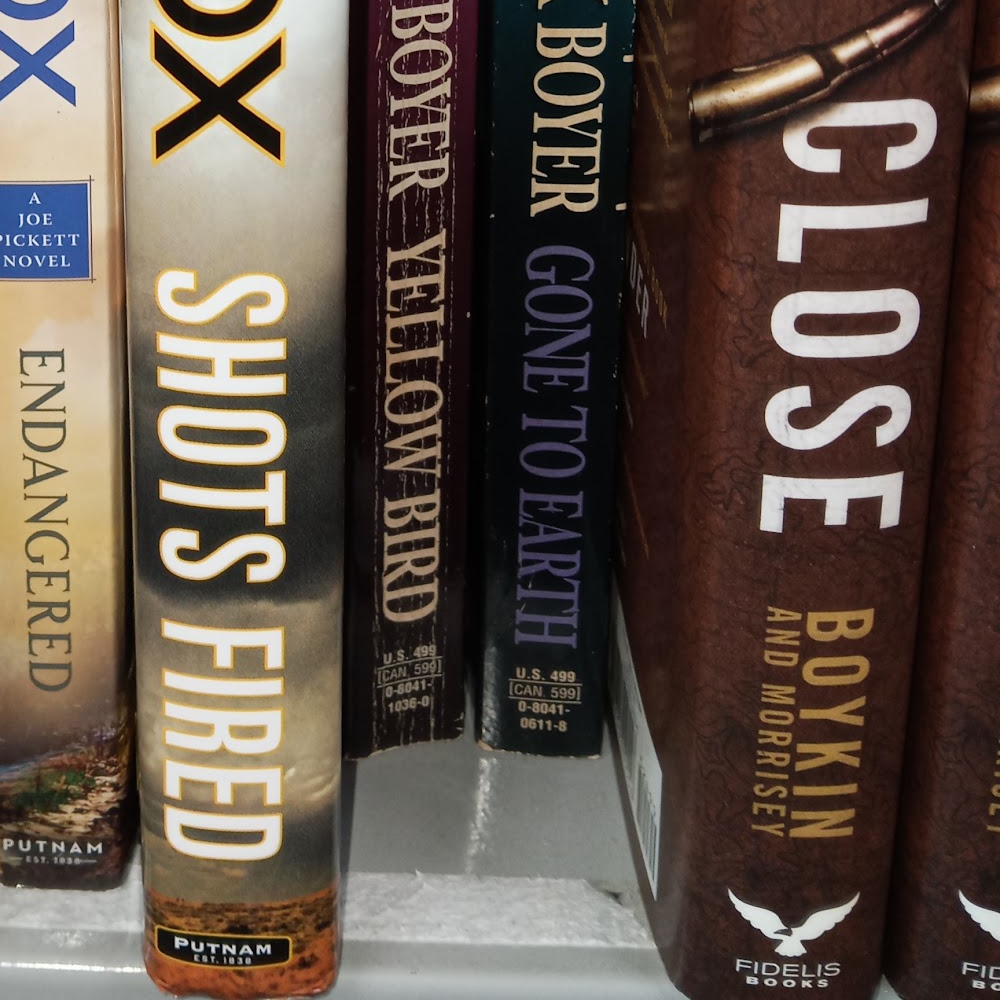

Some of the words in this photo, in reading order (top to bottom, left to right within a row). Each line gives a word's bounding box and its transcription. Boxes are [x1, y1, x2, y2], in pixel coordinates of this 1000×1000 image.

[529, 21, 609, 218] BOYER
[28, 191, 42, 205] A
[18, 212, 54, 229] JOE
[3, 254, 72, 269] NOVEL
[522, 244, 596, 393] GONE
[759, 97, 938, 534] CLOSE
[382, 226, 448, 479] YELLOW
[154, 267, 289, 585] SHOTS
[518, 405, 590, 479] TO
[18, 347, 74, 693] ENDANGERED
[382, 486, 443, 623] BIRD
[514, 486, 585, 650] EARTH
[762, 605, 803, 668] AND
[383, 648, 410, 665] U.S.
[413, 644, 438, 658] 499
[515, 666, 546, 681] U.S.
[549, 670, 577, 683] 499
[385, 678, 433, 698] 0-8041-
[387, 694, 431, 714] 1036-0
[517, 700, 571, 716] 0-8041-
[519, 716, 569, 732] 0611-8
[788, 607, 876, 839] BOYKIN
[160, 616, 286, 862] FIRED
[750, 682, 798, 839] MORRISEY
[2, 838, 104, 855] PUTNAM
[173, 935, 273, 956] PUTNAM
[193, 953, 220, 964] EST.
[735, 958, 842, 978] FIDELIS
[745, 976, 830, 989] BOOKS
